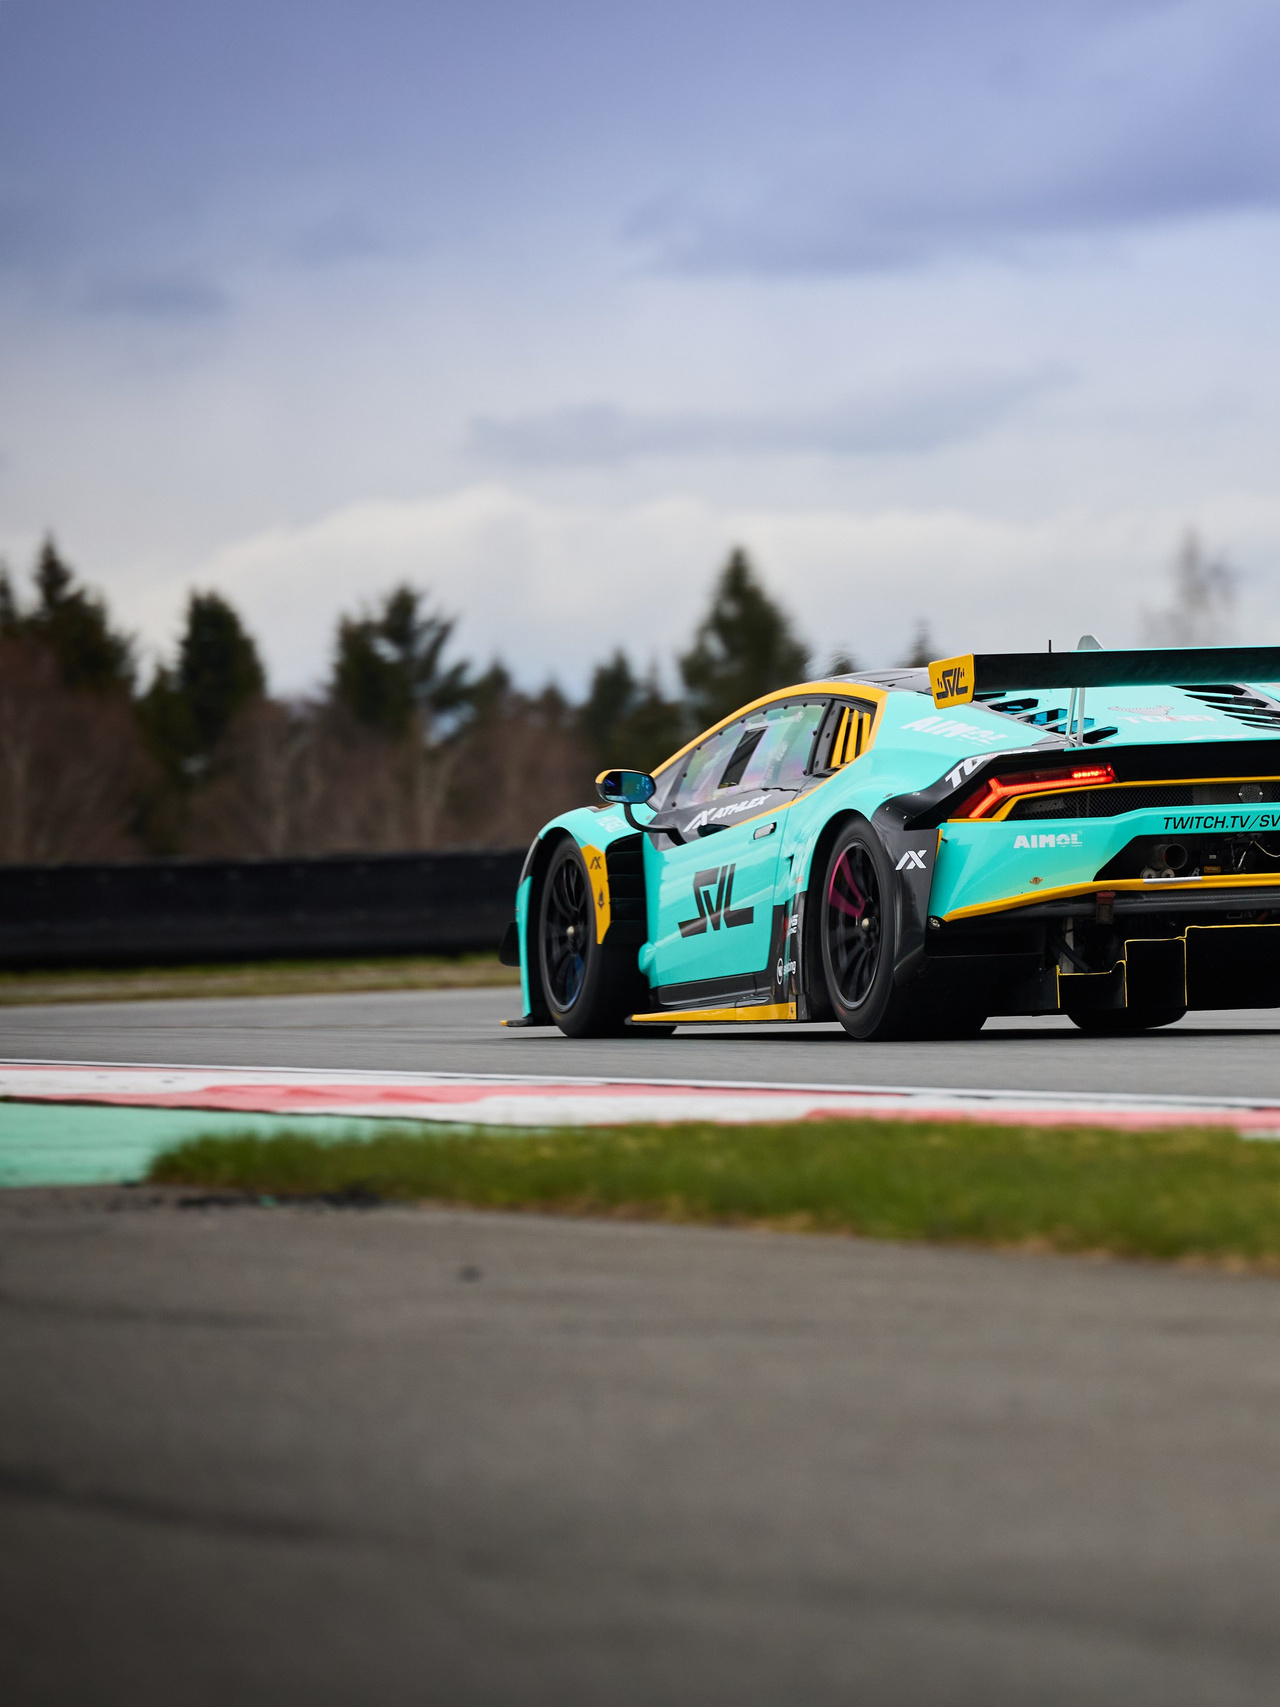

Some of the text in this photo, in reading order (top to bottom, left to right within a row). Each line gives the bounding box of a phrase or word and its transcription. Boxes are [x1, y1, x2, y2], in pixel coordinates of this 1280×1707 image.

[710, 794, 771, 821] ATHLEX
[1013, 833, 1083, 848] AIMOL
[678, 863, 754, 938] SVL
